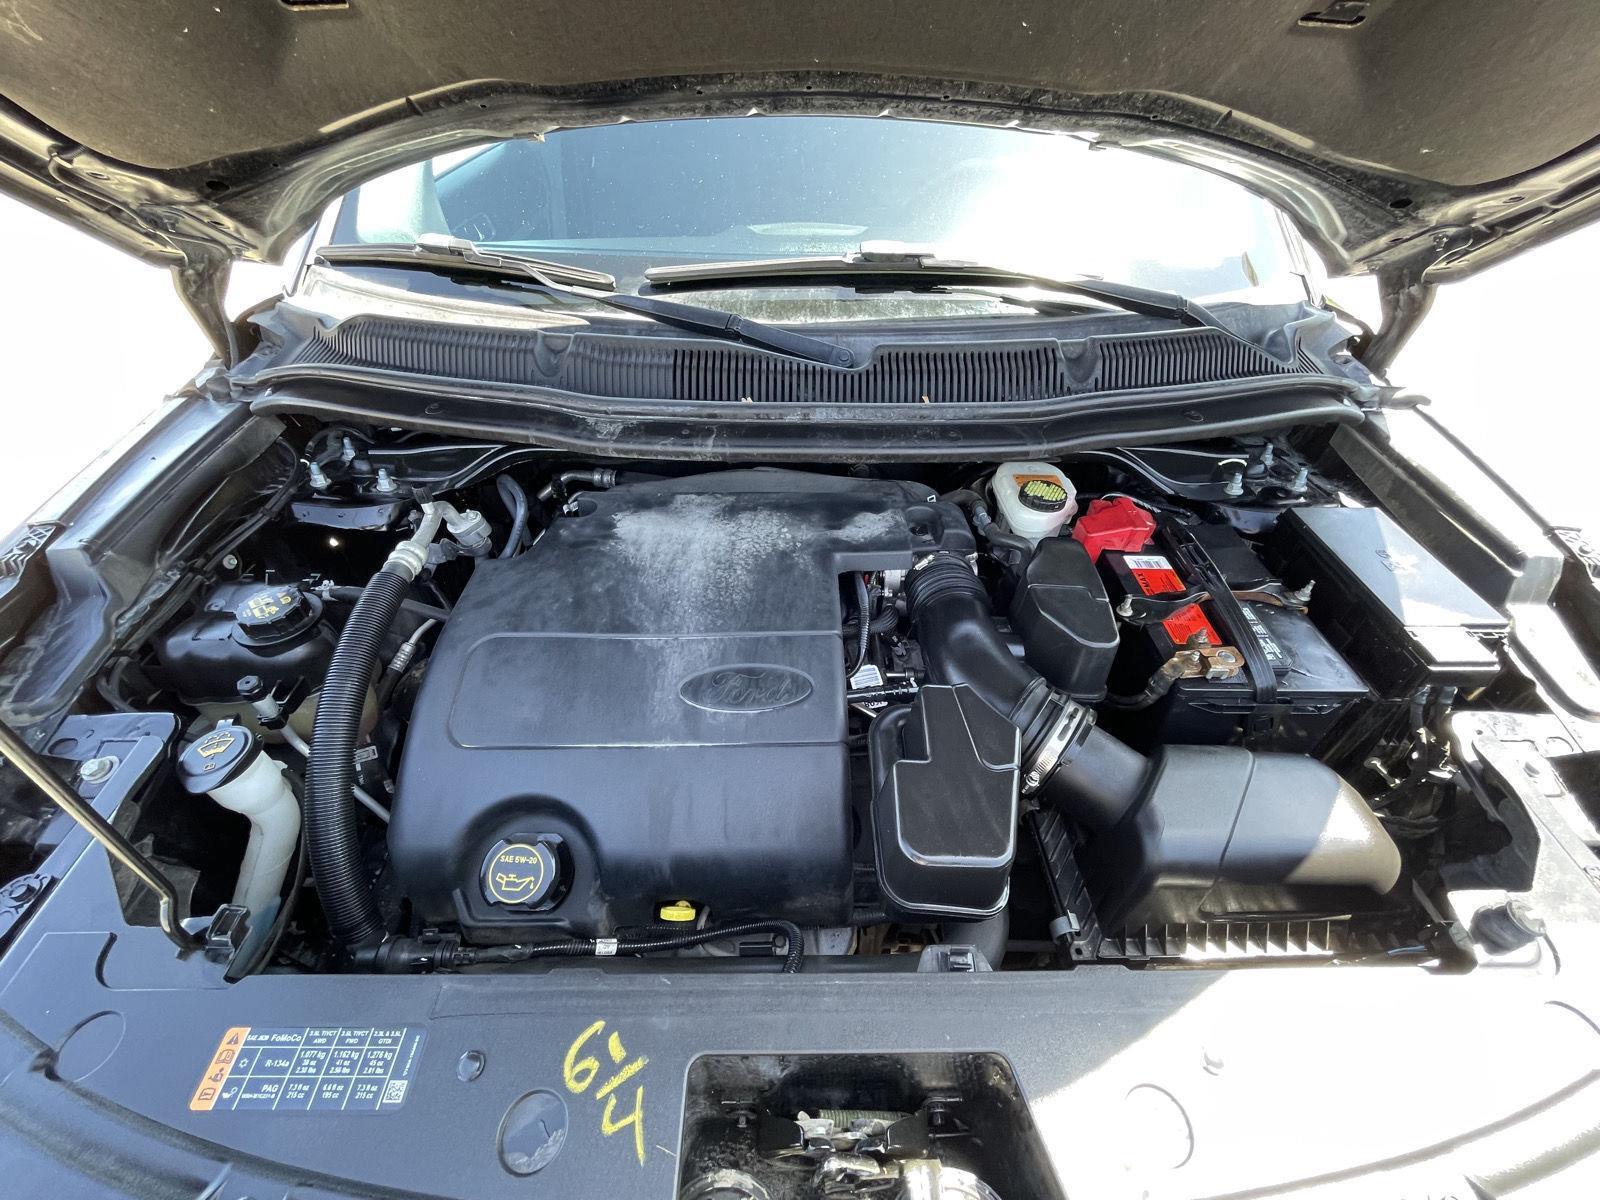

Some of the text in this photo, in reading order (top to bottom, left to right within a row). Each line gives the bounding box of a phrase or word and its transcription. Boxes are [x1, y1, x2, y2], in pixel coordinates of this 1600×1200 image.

[704, 670, 799, 706] Ford
[500, 855, 538, 864] SAE 5W-20
[271, 1033, 302, 1042] FoMoCo
[300, 1050, 326, 1060] 1.077 kg
[334, 1050, 360, 1060] 1.162 kg
[367, 1050, 393, 1060] 1.276 kg
[265, 1059, 290, 1067] R-134a
[261, 1084, 279, 1092] PAG
[355, 1091, 366, 1099] 215
